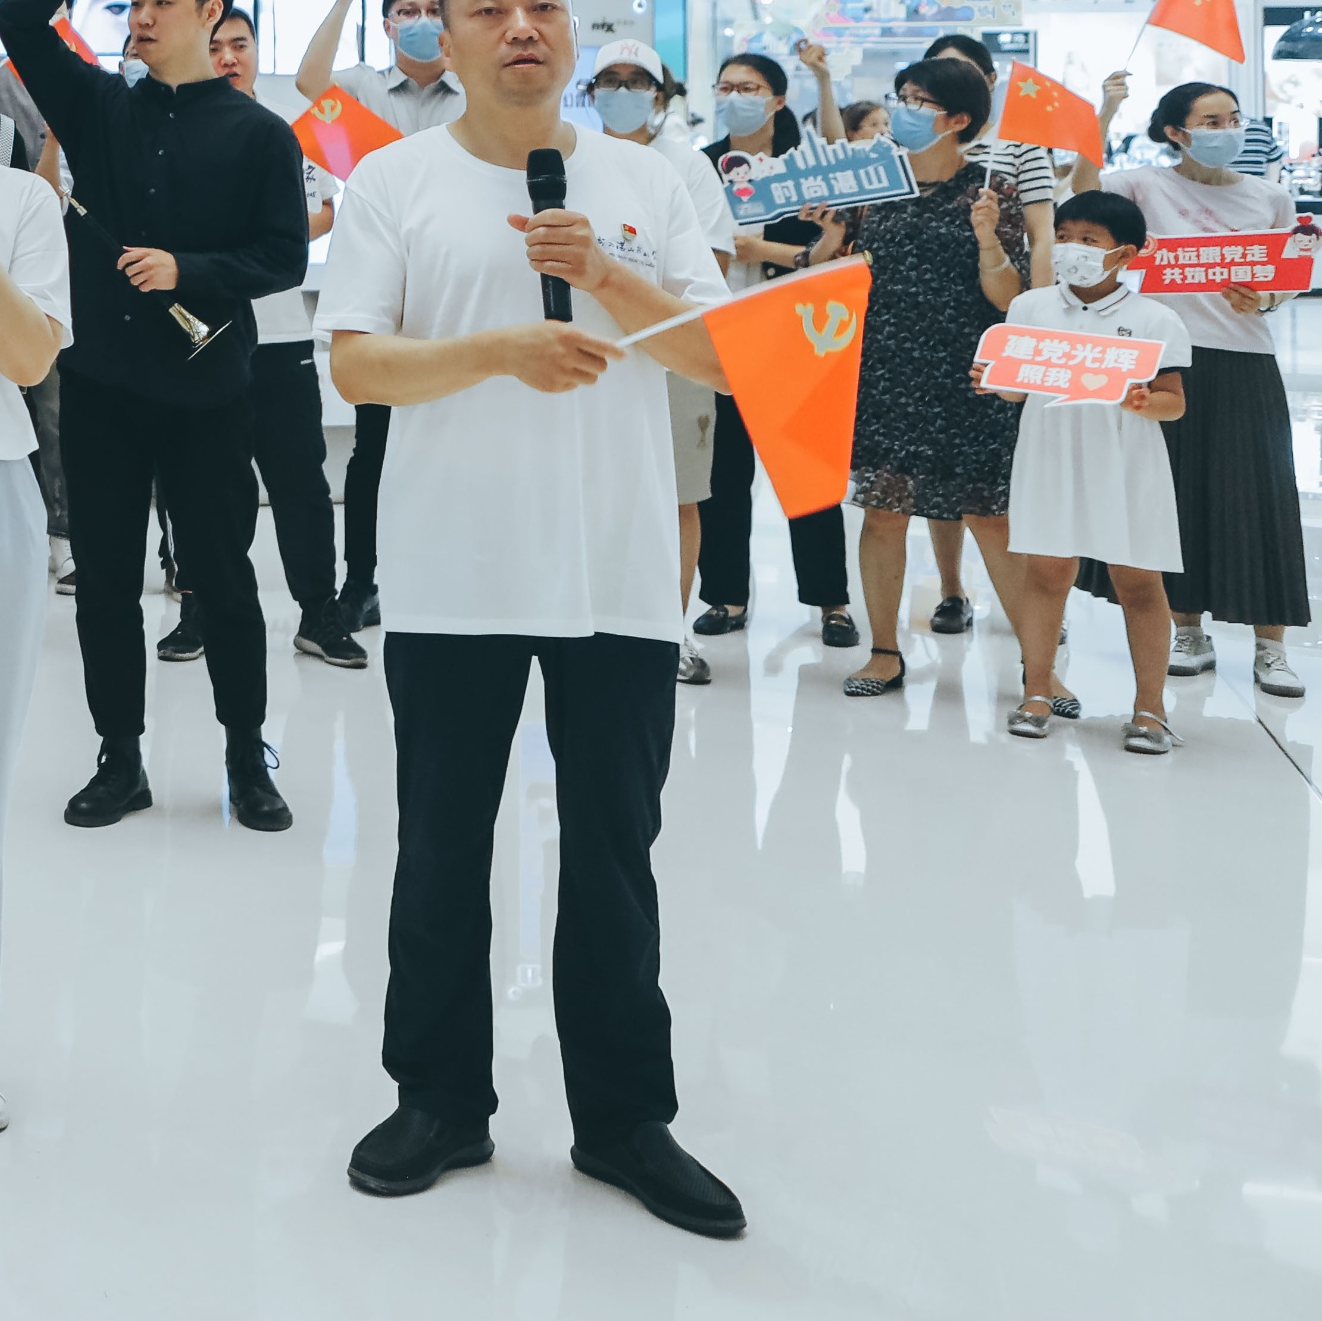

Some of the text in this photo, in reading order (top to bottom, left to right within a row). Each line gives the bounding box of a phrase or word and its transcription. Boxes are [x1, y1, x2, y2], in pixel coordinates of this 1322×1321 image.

[769, 164, 890, 205] 时尚湛山
[1154, 244, 1269, 266] 永远跟党走
[1161, 264, 1277, 285] 共筑中国梦
[1001, 334, 1140, 372] 建党光辉
[1015, 364, 1072, 388] 照我
